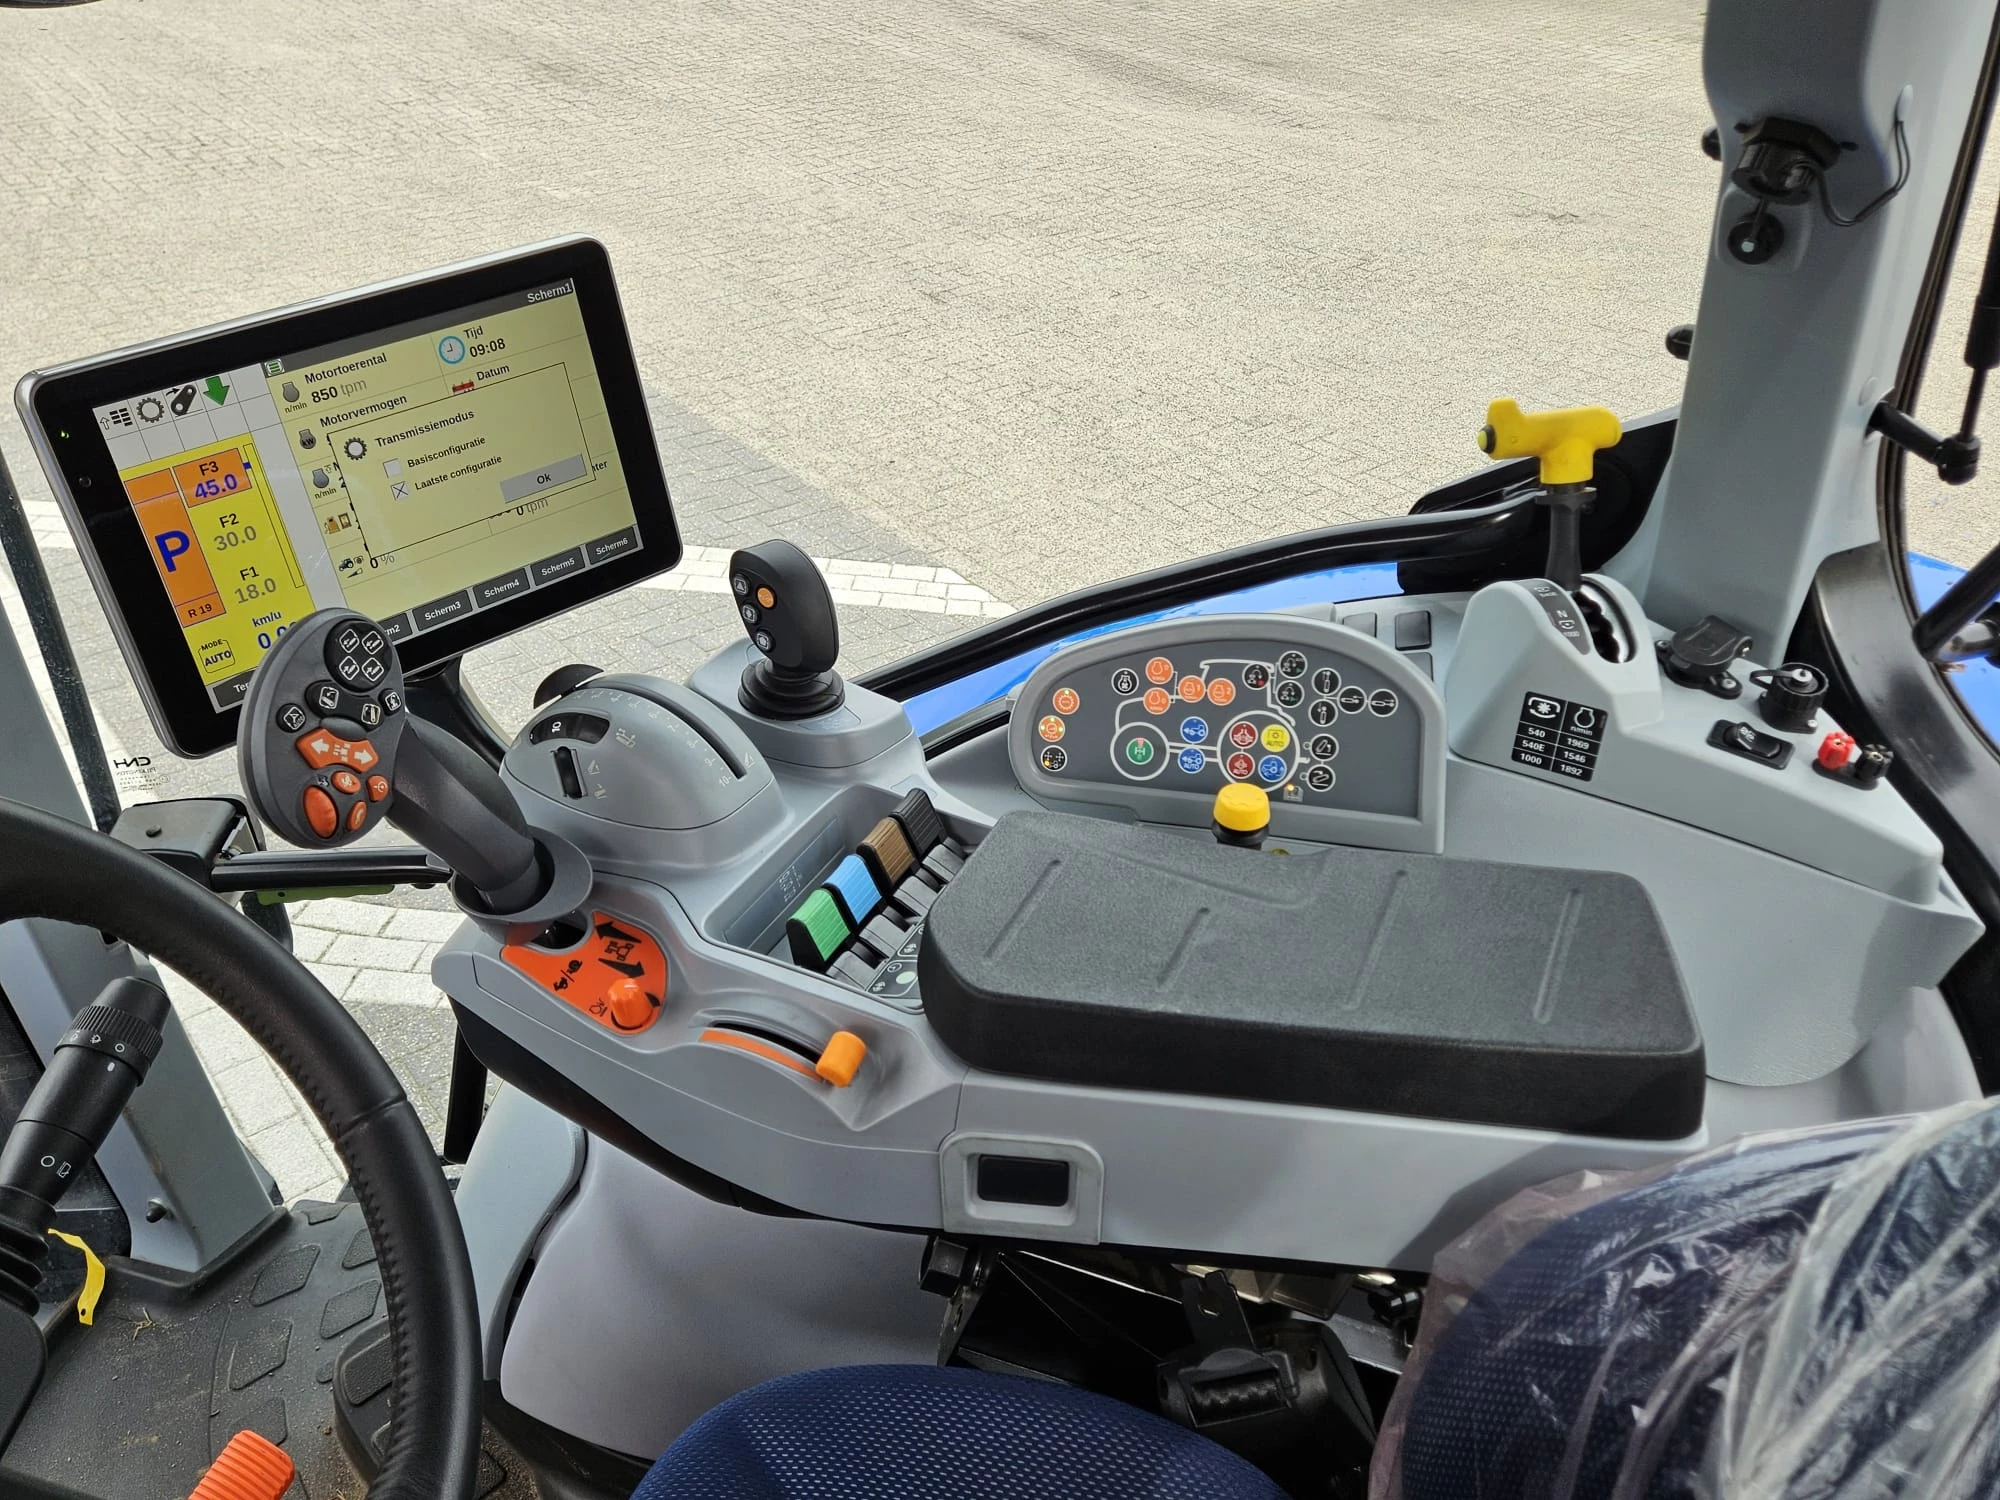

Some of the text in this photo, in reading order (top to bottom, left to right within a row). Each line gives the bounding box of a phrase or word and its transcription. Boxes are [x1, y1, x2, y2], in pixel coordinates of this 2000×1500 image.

[527, 283, 573, 303] Scherm1
[464, 326, 484, 340] Tijd
[469, 338, 506, 358] 09:08
[305, 352, 387, 385] Motortoerental
[476, 364, 510, 381] Datum
[311, 379, 367, 403] 850 tpm
[285, 401, 307, 415] n/min
[320, 394, 408, 428] Motorvermogen
[375, 409, 475, 448] Transmissiemodus
[407, 436, 486, 468] Basisconfiguratie
[199, 461, 219, 476] F3
[414, 455, 502, 491] Laatste configuratie
[195, 474, 238, 498] 45.0
[536, 473, 551, 485] Ok
[314, 488, 337, 499] n/min
[525, 498, 549, 514] tpm
[219, 513, 239, 528] F2
[214, 525, 257, 551] 30.0
[155, 530, 190, 572] P
[595, 537, 628, 556] Scherm6
[240, 566, 259, 581] F1
[541, 557, 575, 577] Scherm5
[234, 577, 276, 604] 18.0
[484, 578, 520, 599] Scherm4
[188, 603, 212, 618] R 19
[424, 601, 461, 621] Scherm3
[252, 611, 281, 628] km/u
[201, 638, 223, 651] MODE
[204, 650, 232, 666] AUTO
[551, 721, 561, 733] 10
[1528, 727, 1546, 738] 540
[1522, 740, 1545, 752] 540E
[1567, 738, 1589, 750] 1969
[1520, 753, 1542, 765] 1000
[1563, 751, 1586, 763] 1546
[1560, 764, 1583, 776] 1892
[719, 775, 730, 787] 10
